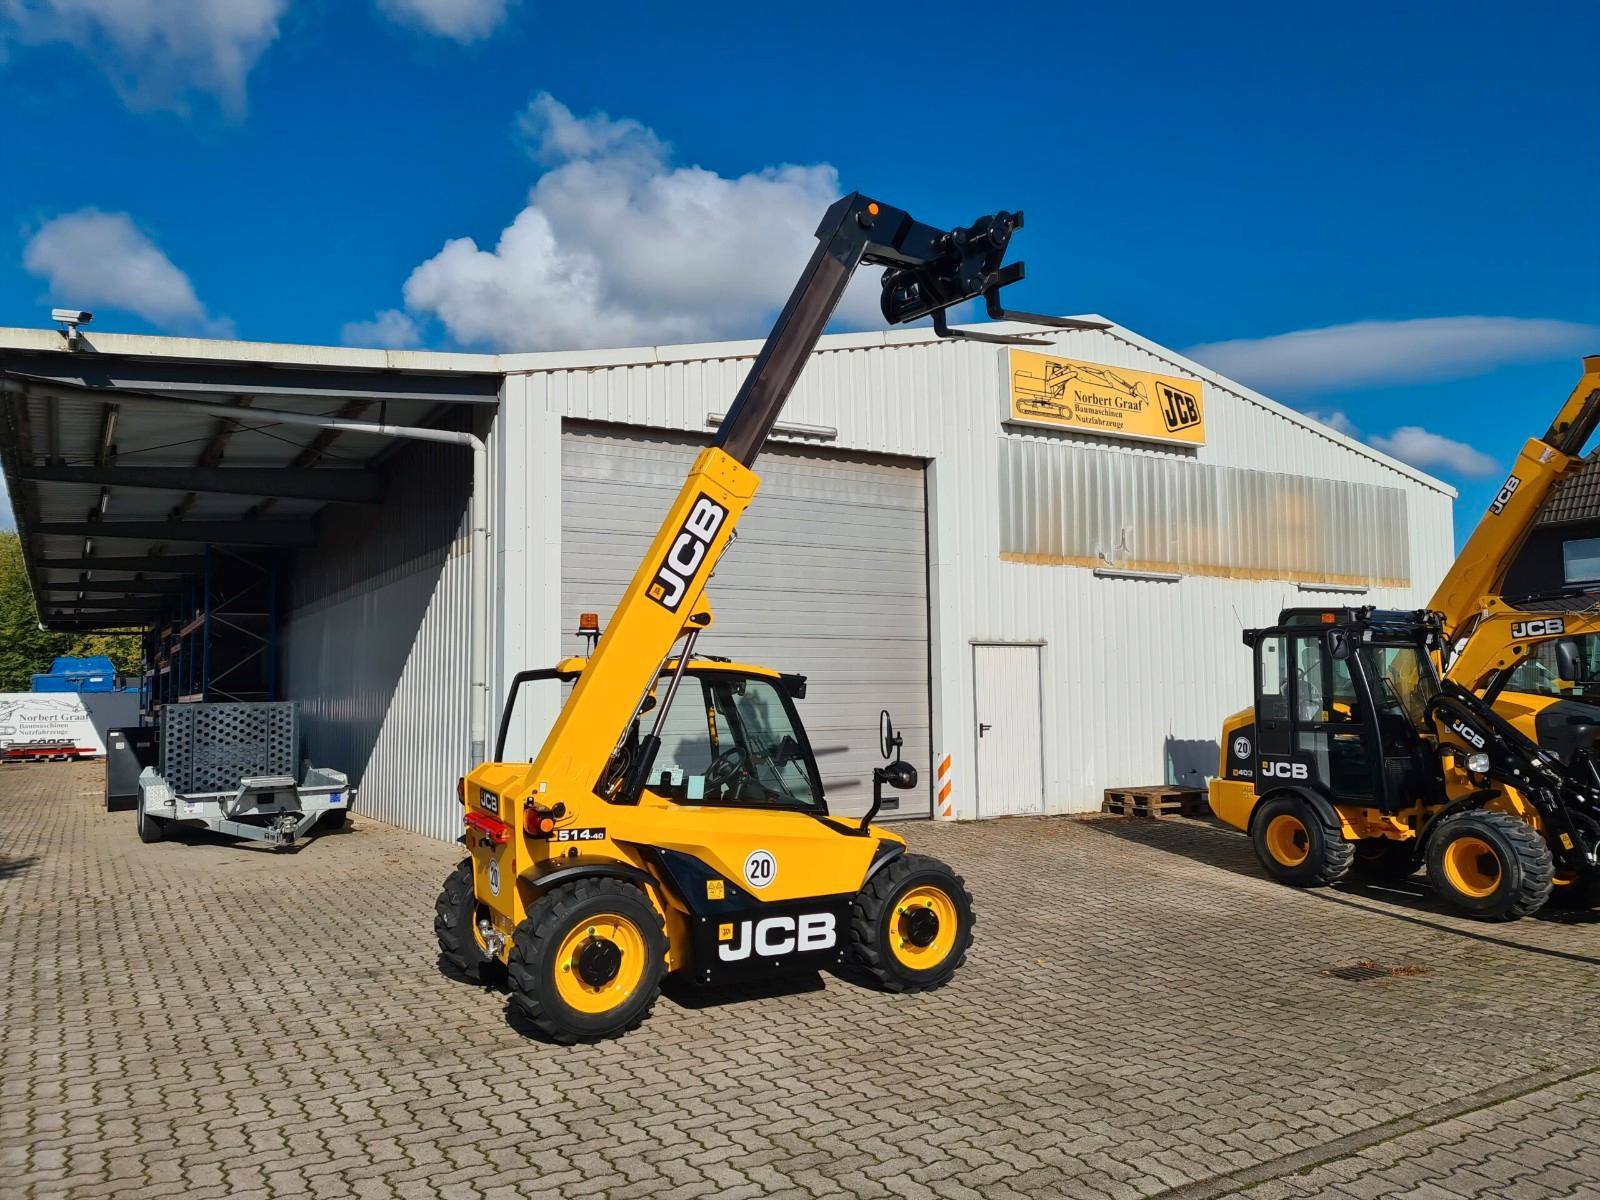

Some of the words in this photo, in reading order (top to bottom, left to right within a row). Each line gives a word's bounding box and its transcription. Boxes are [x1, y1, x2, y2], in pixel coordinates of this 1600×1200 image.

[1074, 390, 1112, 406] Norbert
[1114, 396, 1143, 411] Graaf
[1074, 404, 1123, 418] Baumaschinen
[1164, 388, 1197, 427] JCB
[1075, 414, 1124, 429] Nutzfahrzeuge
[1493, 476, 1520, 515] JCB
[658, 498, 724, 607] JCB
[1512, 619, 1564, 637] JCB
[1452, 723, 1485, 749] JCB
[1237, 742, 1248, 754] 20
[1262, 761, 1308, 780] JCB
[480, 790, 498, 812] JCB
[750, 859, 771, 879] 20
[718, 912, 837, 962] JCB
